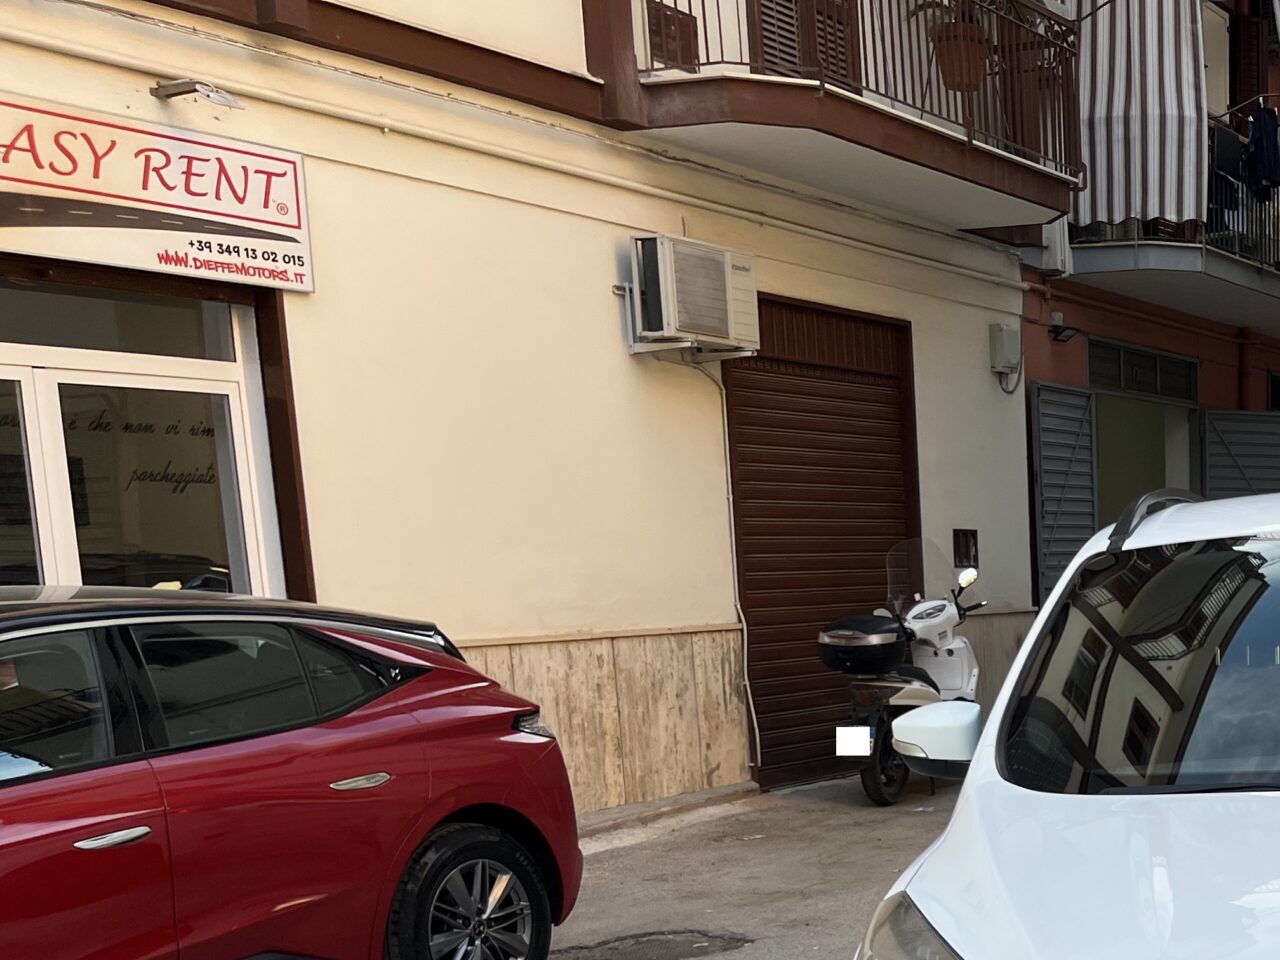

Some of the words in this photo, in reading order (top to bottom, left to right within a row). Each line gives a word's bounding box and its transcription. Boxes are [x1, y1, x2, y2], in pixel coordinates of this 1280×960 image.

[0, 124, 117, 179] ASY
[134, 148, 287, 209] RENT
[157, 249, 306, 284] WWW.DIEFFEMOTORS.IT
[188, 240, 212, 253] +39
[217, 243, 241, 257] 349
[244, 247, 258, 259] 13
[261, 251, 279, 263] 02
[282, 254, 305, 267] 015
[88, 409, 113, 433] che
